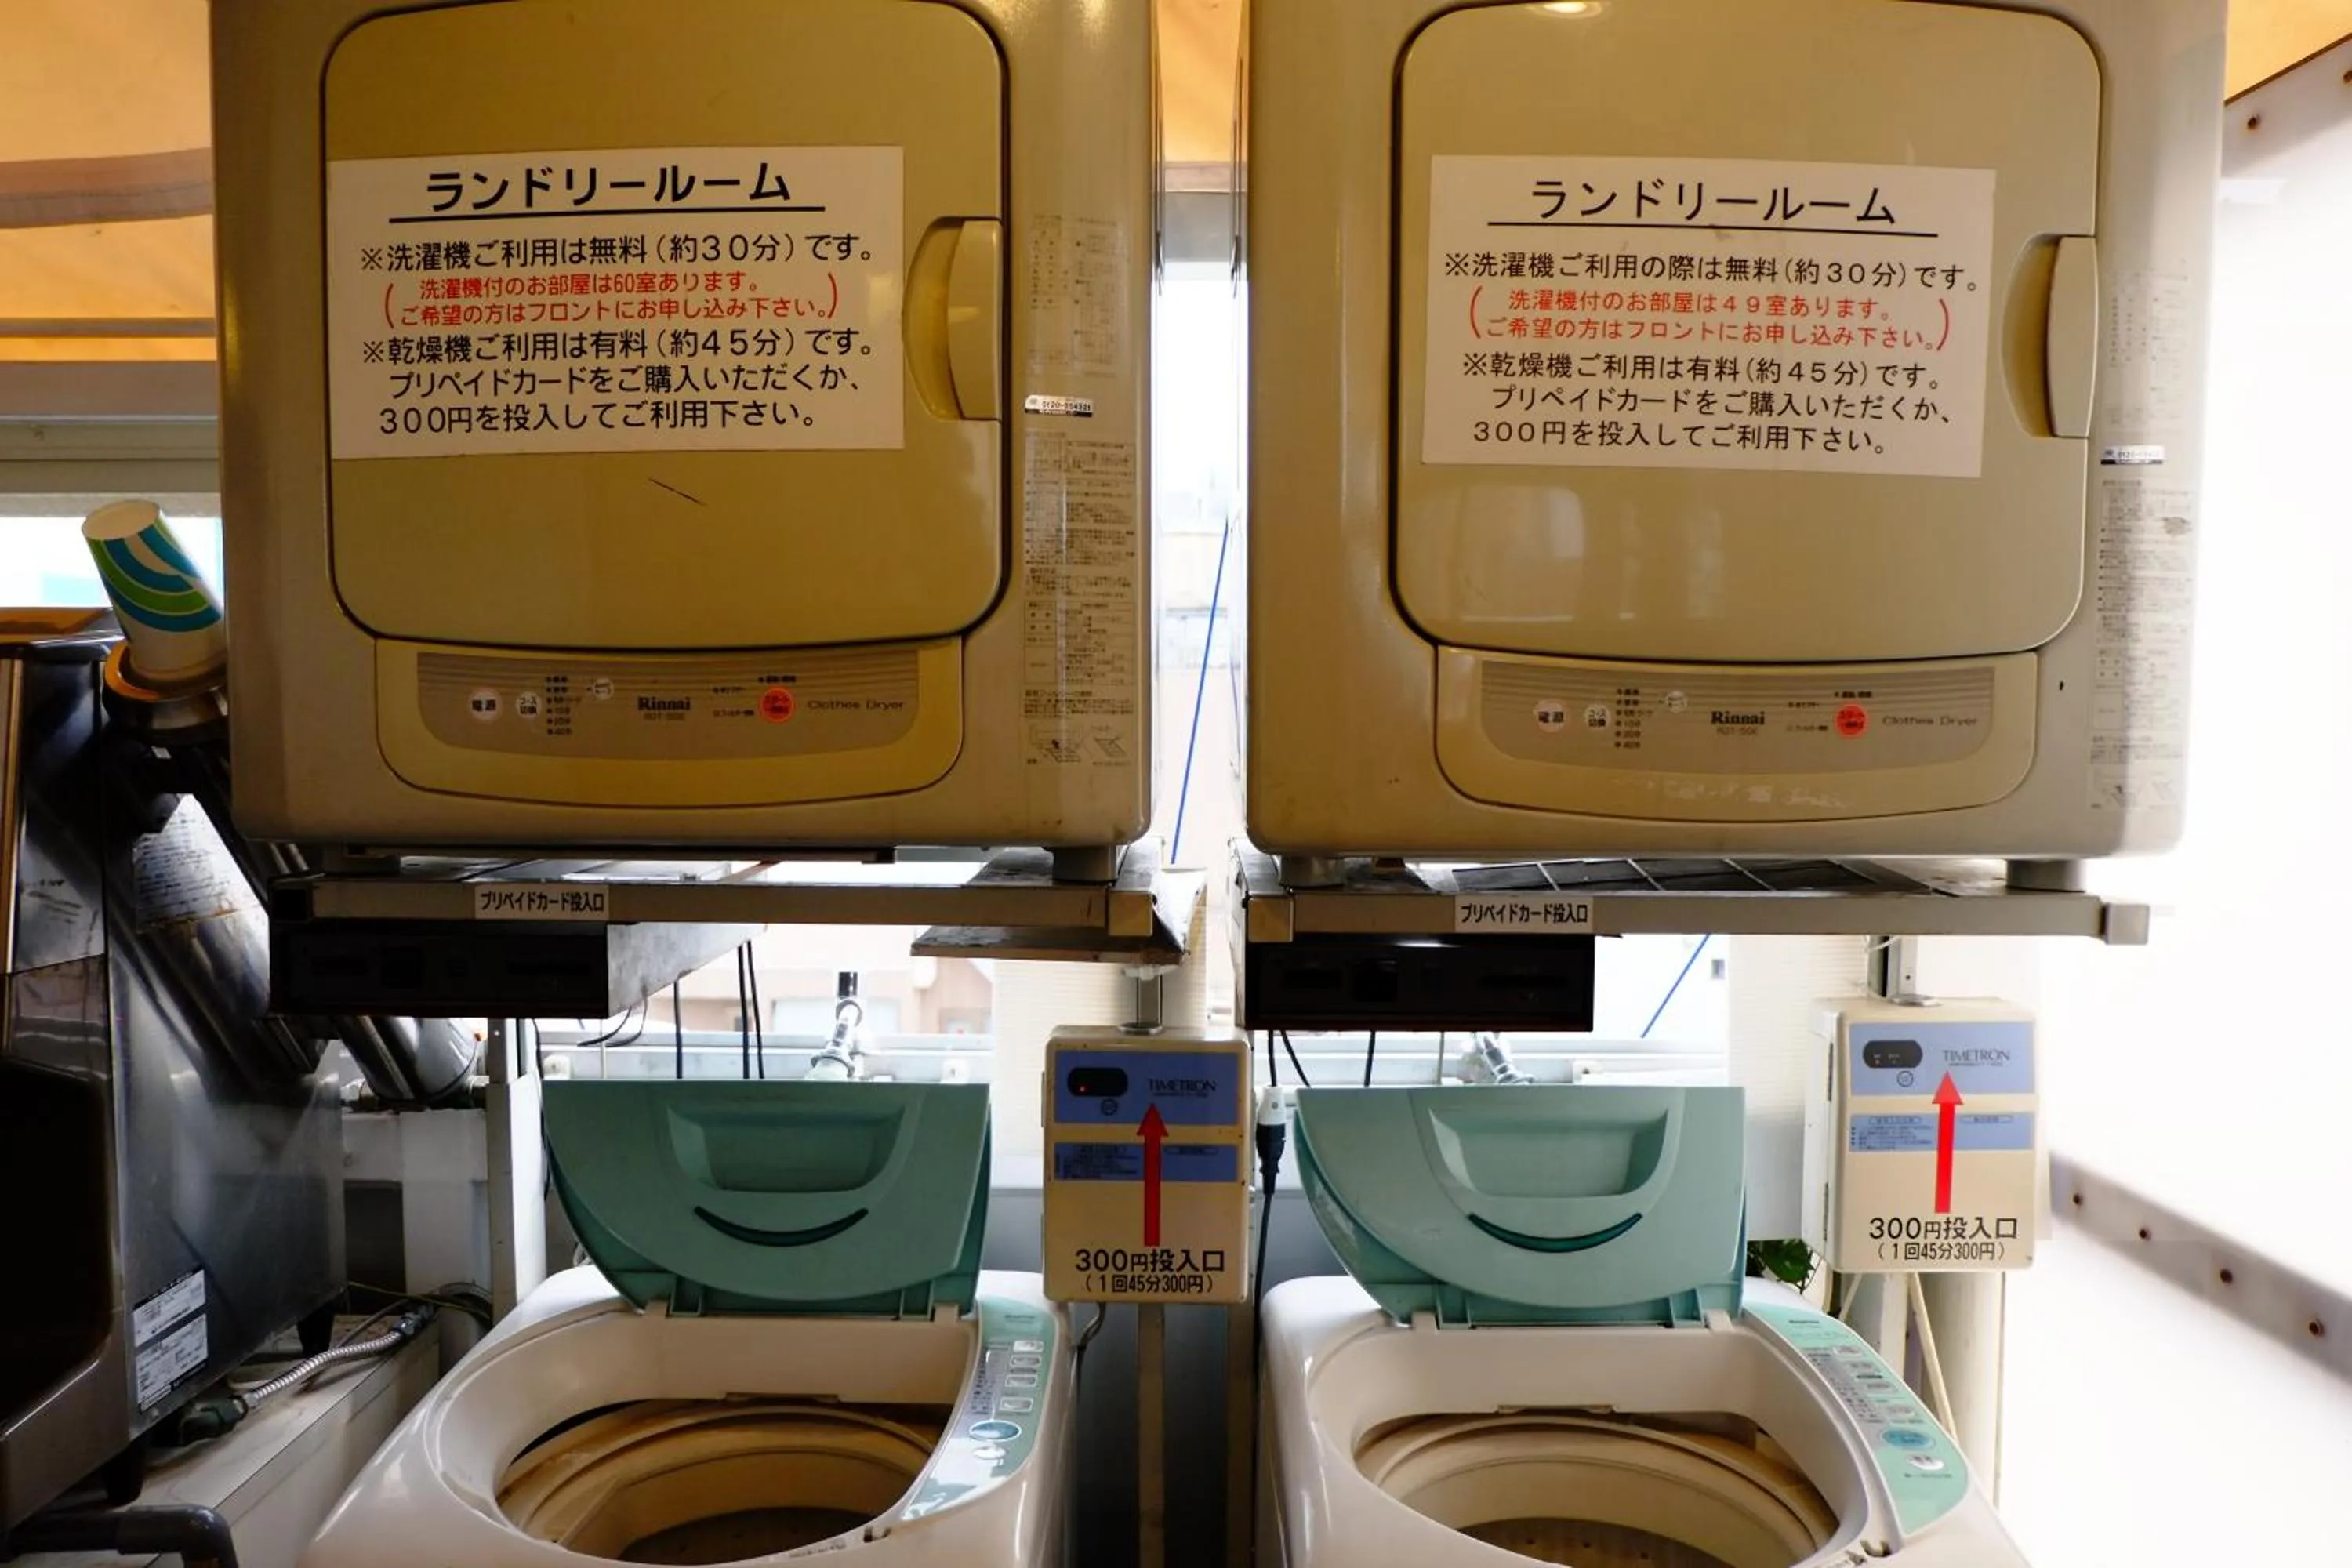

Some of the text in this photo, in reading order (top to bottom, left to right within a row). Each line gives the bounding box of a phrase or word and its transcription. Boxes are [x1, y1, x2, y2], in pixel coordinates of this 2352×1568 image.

[426, 162, 790, 212] ランドリールーム
[1531, 179, 1896, 225] ランドリールーム
[390, 364, 859, 398] プリペイドカードをご購入いただくか、
[1494, 387, 1951, 423] プリペイドカードをご購入いただくか、
[379, 400, 814, 434] 300円を投入してご利用下さい。
[1474, 420, 1885, 454] 300円を投入してご利用下さい。
[637, 696, 691, 710] Rinnai
[1711, 710, 1765, 725] Rinnai
[481, 891, 604, 911] プリペイドカード投入口
[1461, 902, 1588, 923] プリペイドカード投入口
[1942, 1047, 2010, 1062] TIMETRON
[1148, 1077, 1217, 1092] TIMETRON
[1869, 1217, 2017, 1240] 300円投入口
[1075, 1248, 1225, 1272] 300円投入口
